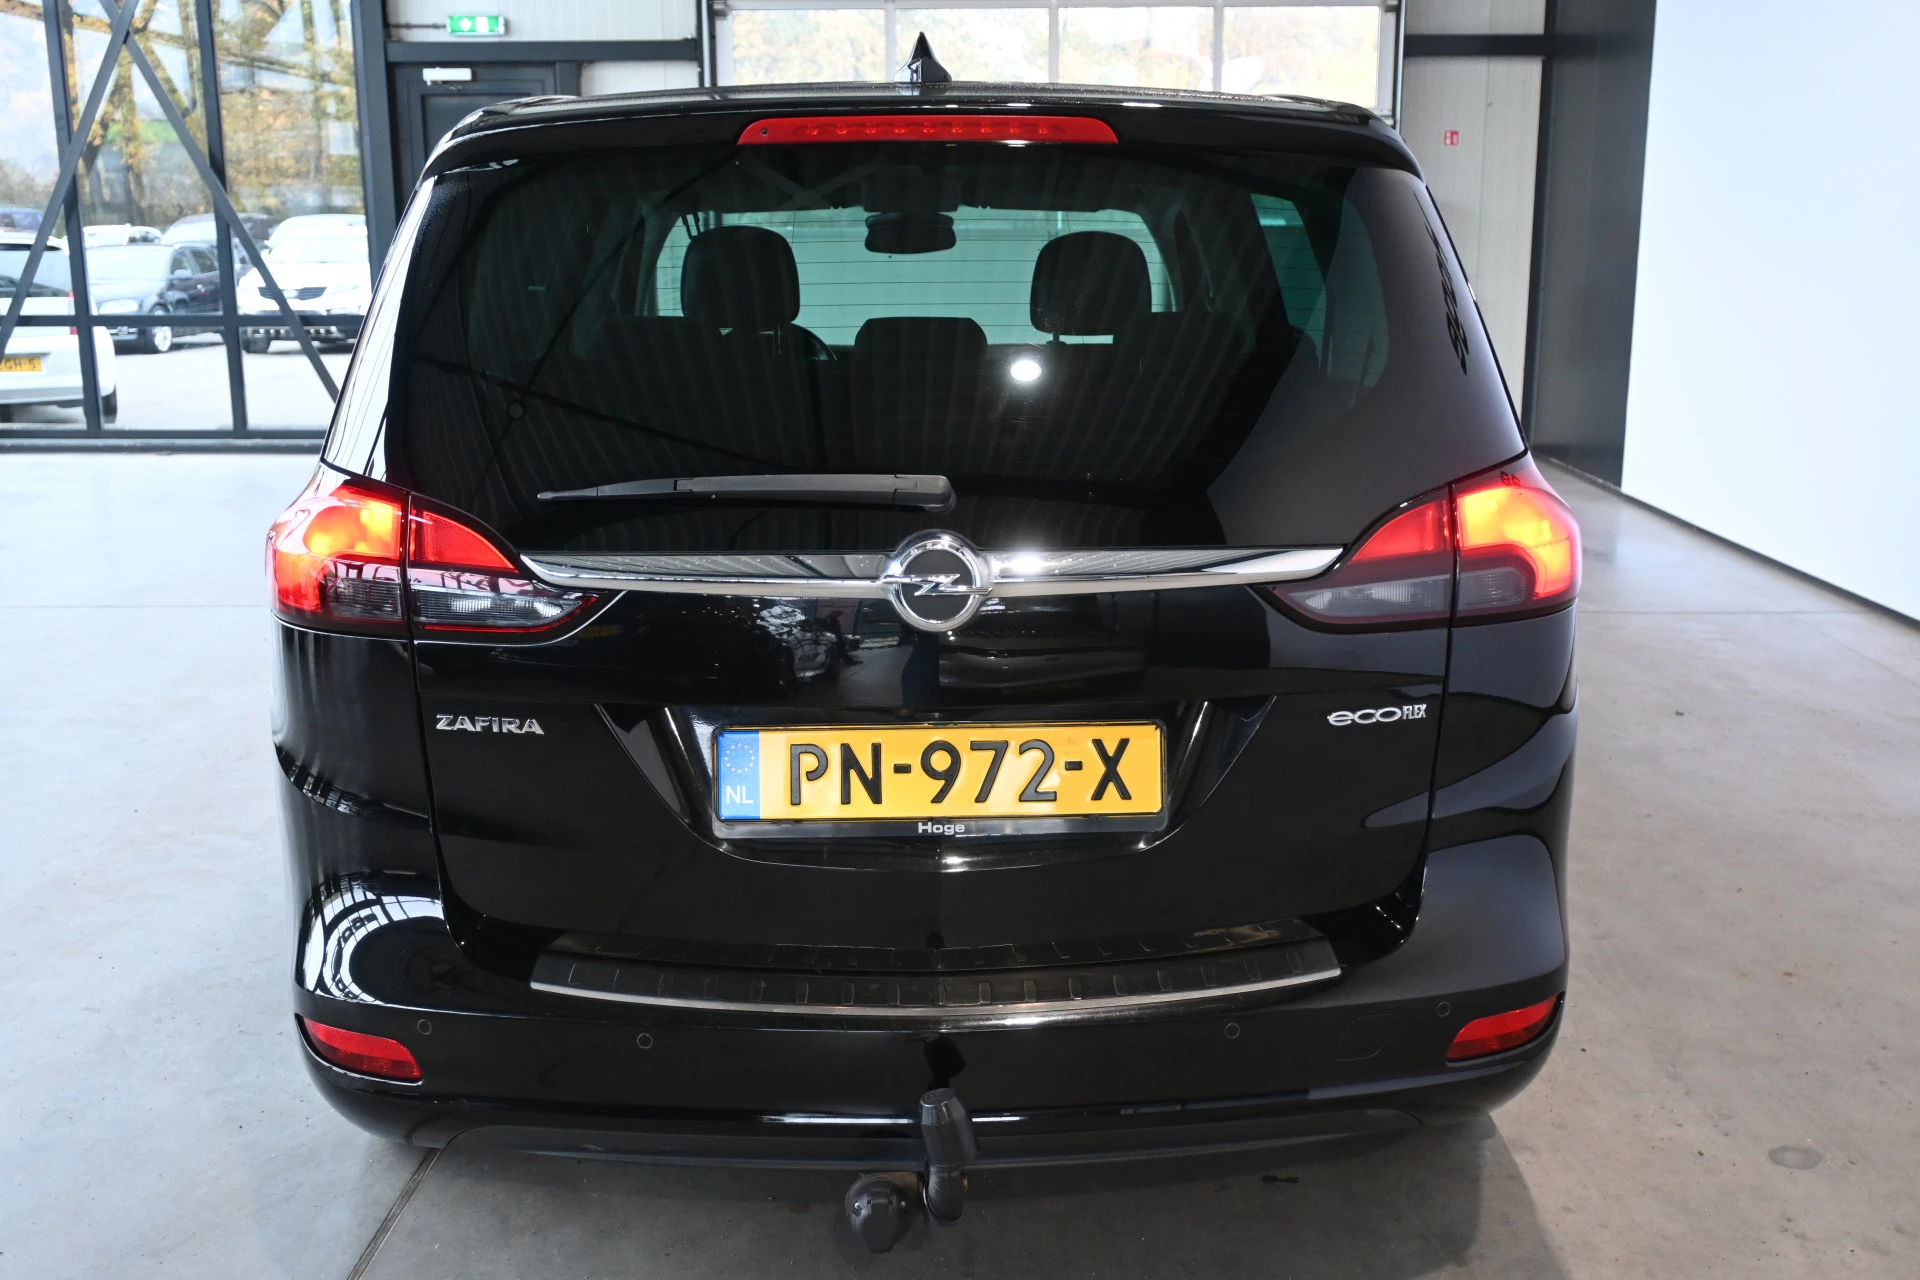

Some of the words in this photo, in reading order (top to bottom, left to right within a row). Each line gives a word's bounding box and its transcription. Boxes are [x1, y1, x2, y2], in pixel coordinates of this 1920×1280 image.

[436, 714, 545, 735] ZAFIRA
[789, 737, 1133, 806] PN-972-X
[725, 786, 754, 805] NL
[918, 821, 966, 836] Hoge
